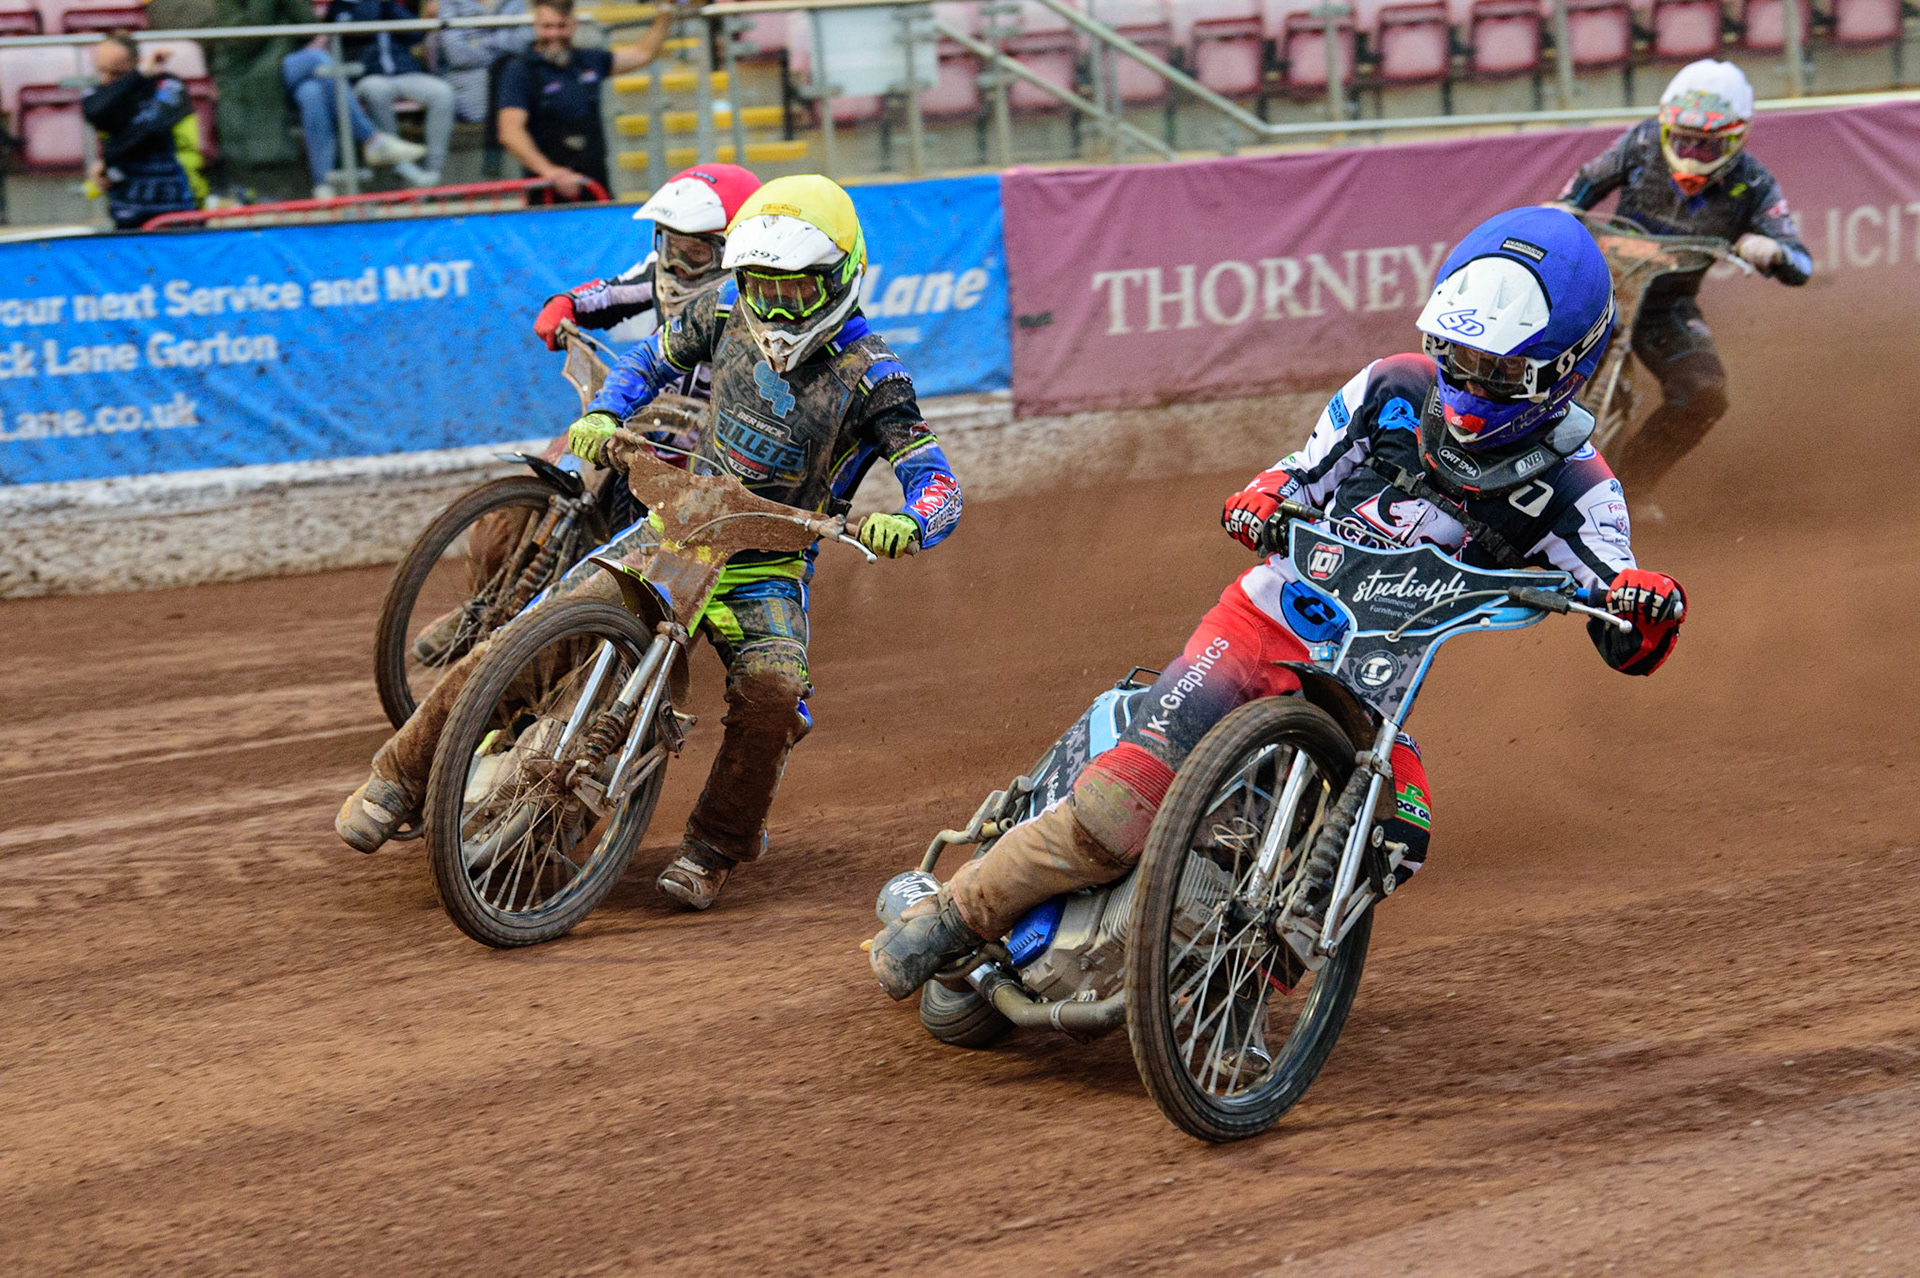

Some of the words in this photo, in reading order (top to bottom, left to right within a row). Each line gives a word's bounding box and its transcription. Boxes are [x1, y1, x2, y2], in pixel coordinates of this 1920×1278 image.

[71, 283, 158, 323] next
[163, 274, 302, 317] Service
[310, 266, 379, 307] and
[384, 260, 473, 301] MOT
[860, 264, 987, 319] Lane
[43, 338, 138, 377] Lane
[147, 330, 279, 369] Gorton
[737, 411, 785, 438] BERWICK
[719, 417, 800, 468] BULLETS
[732, 460, 760, 478] TEAM
[1440, 449, 1478, 477] ORTEMA
[1310, 550, 1340, 575] 101
[1369, 604, 1403, 619] Furniture
[1403, 611, 1438, 625] Spialist
[1373, 595, 1418, 609] Commercial
[1147, 636, 1230, 733] K-Graphics
[1396, 800, 1420, 815] OCK
